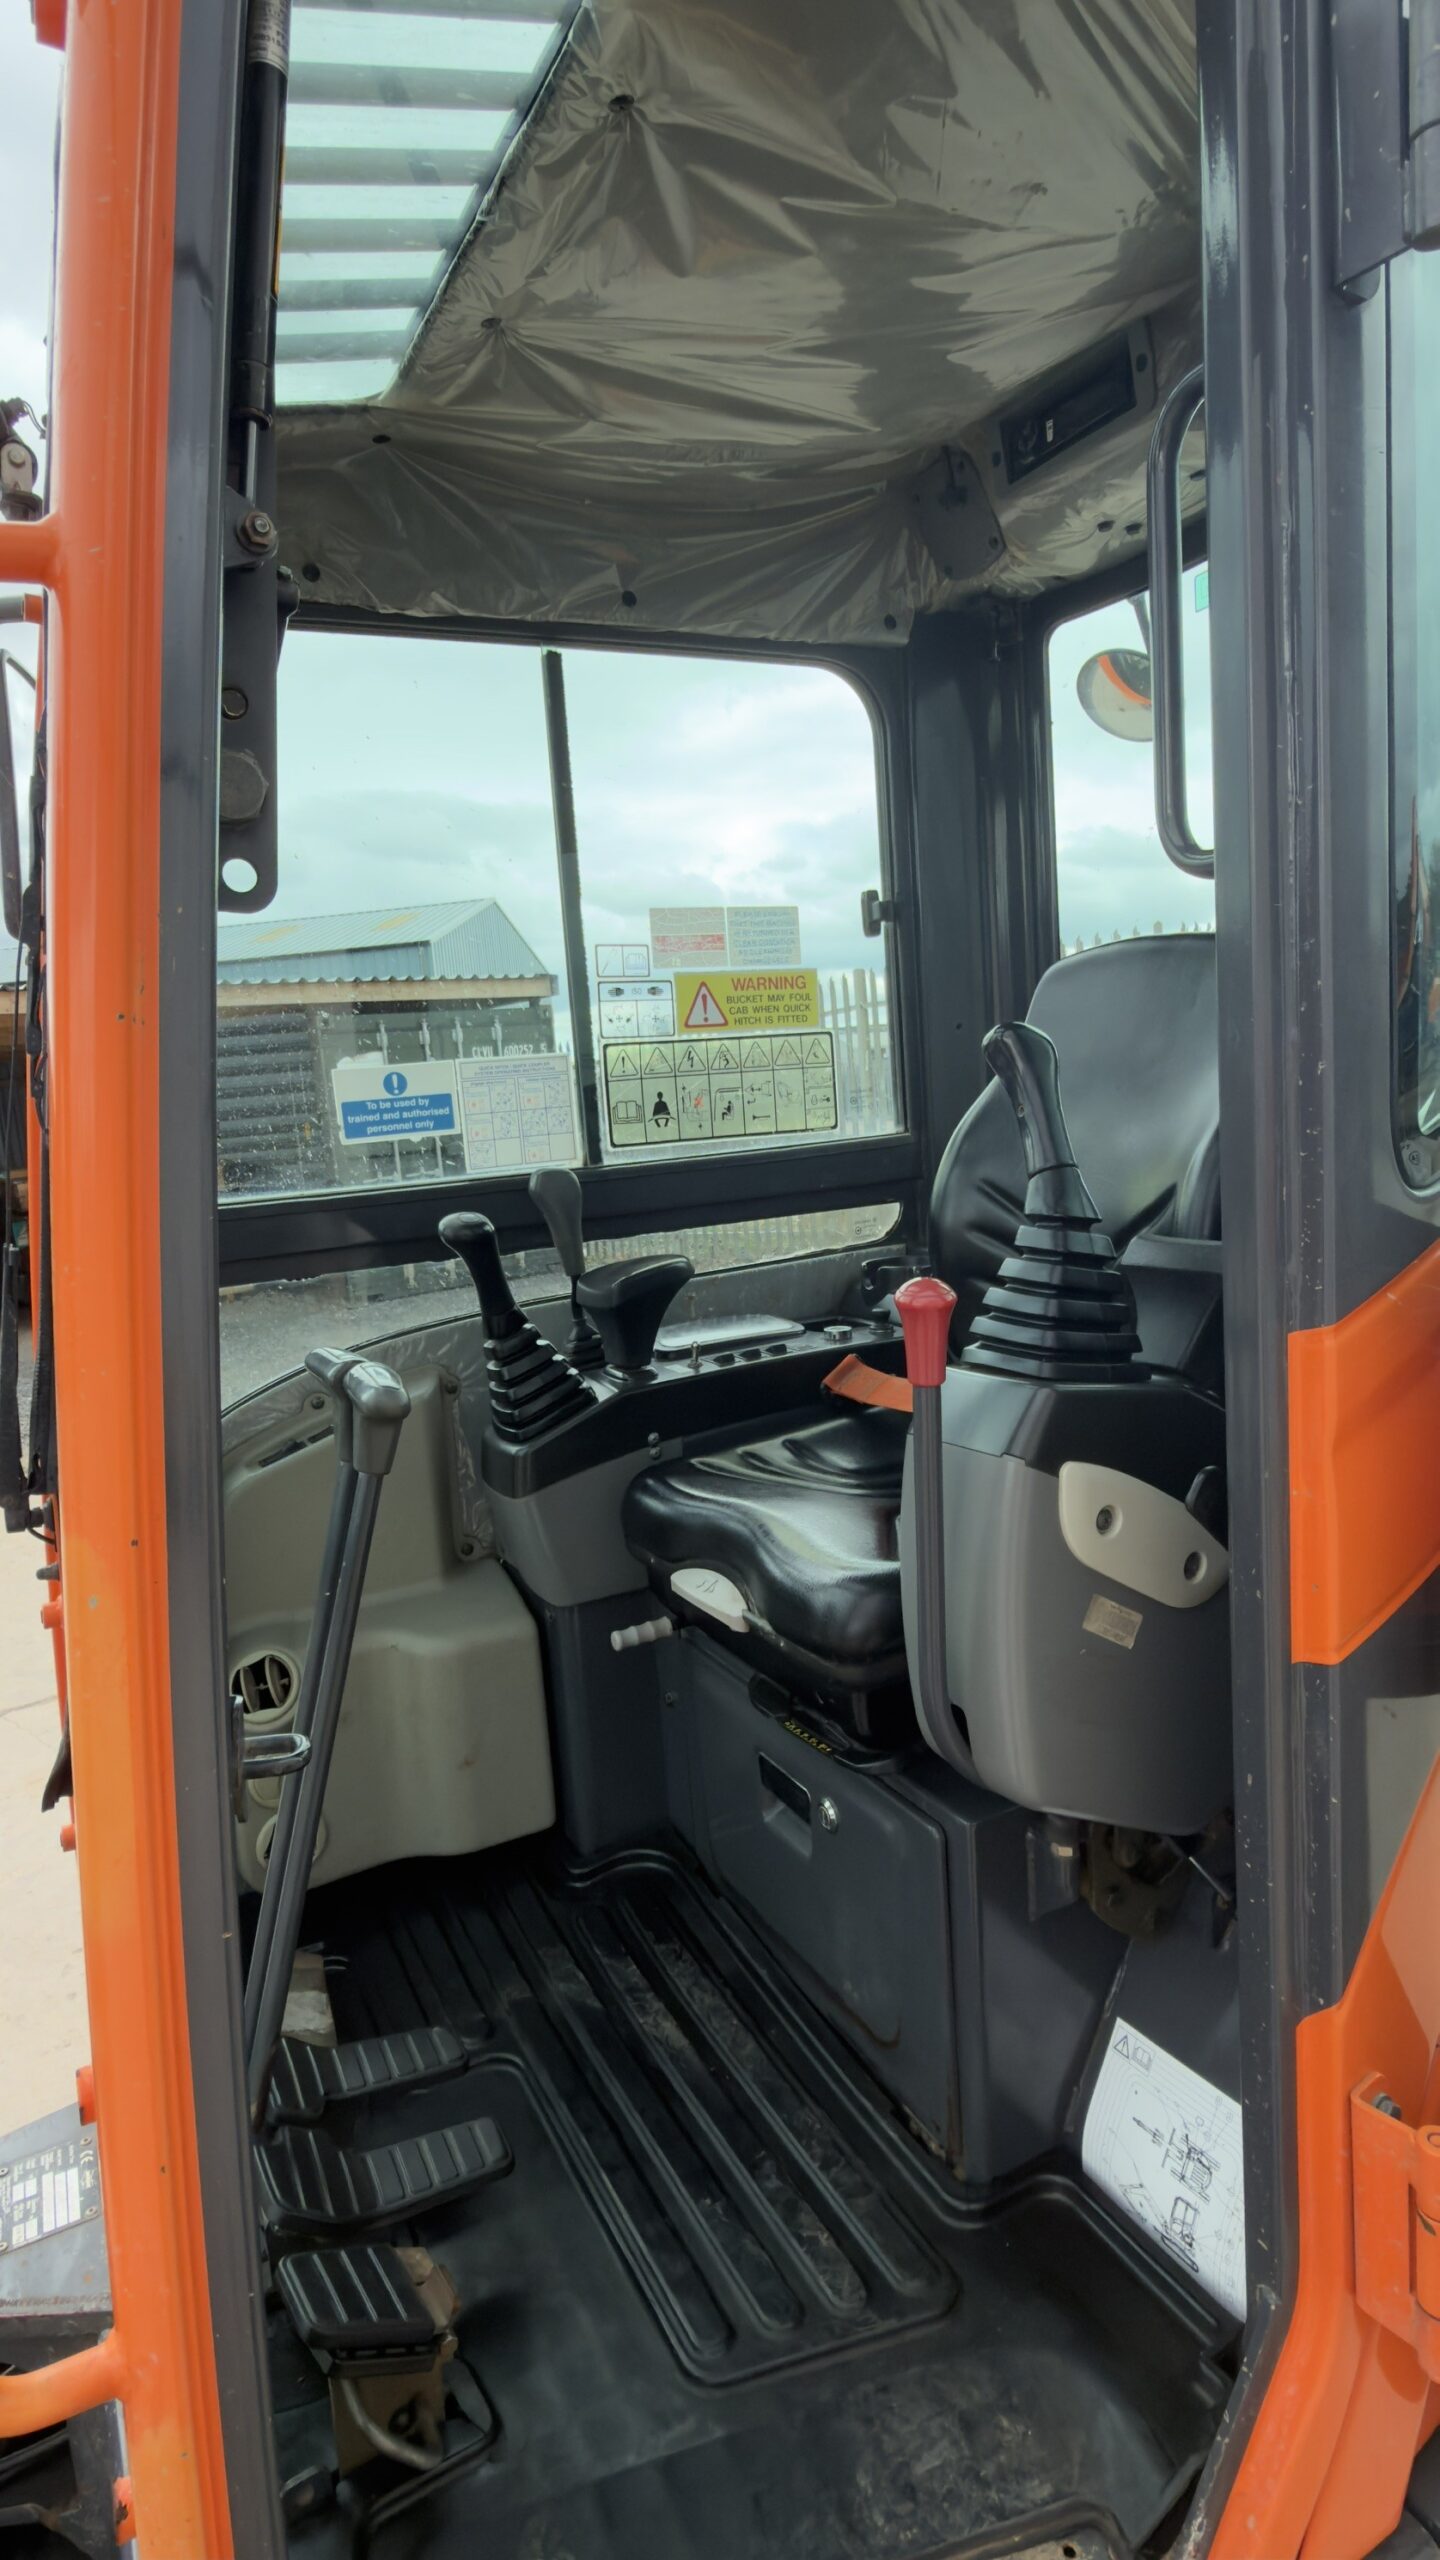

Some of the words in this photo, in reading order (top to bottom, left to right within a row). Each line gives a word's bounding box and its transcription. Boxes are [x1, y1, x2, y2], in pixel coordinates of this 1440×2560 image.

[731, 975, 807, 992] WARNING
[726, 994, 763, 1004] BUCKET
[767, 994, 785, 1002] MAY
[789, 993, 812, 1002] FOUL
[728, 1007, 748, 1015] CAB
[752, 1005, 780, 1014] WHEN
[783, 1004, 811, 1013] QUICK
[734, 1016, 761, 1025] HITCH
[764, 1016, 773, 1024] IS
[777, 1015, 808, 1024] FITTED
[366, 1102, 377, 1110] To
[379, 1100, 391, 1109] be
[393, 1098, 416, 1108] used
[418, 1097, 430, 1107] by
[347, 1112, 380, 1124] trained
[382, 1111, 400, 1120] and
[402, 1107, 450, 1118] authorised
[366, 1121, 413, 1135] personnel
[415, 1119, 434, 1130] only
